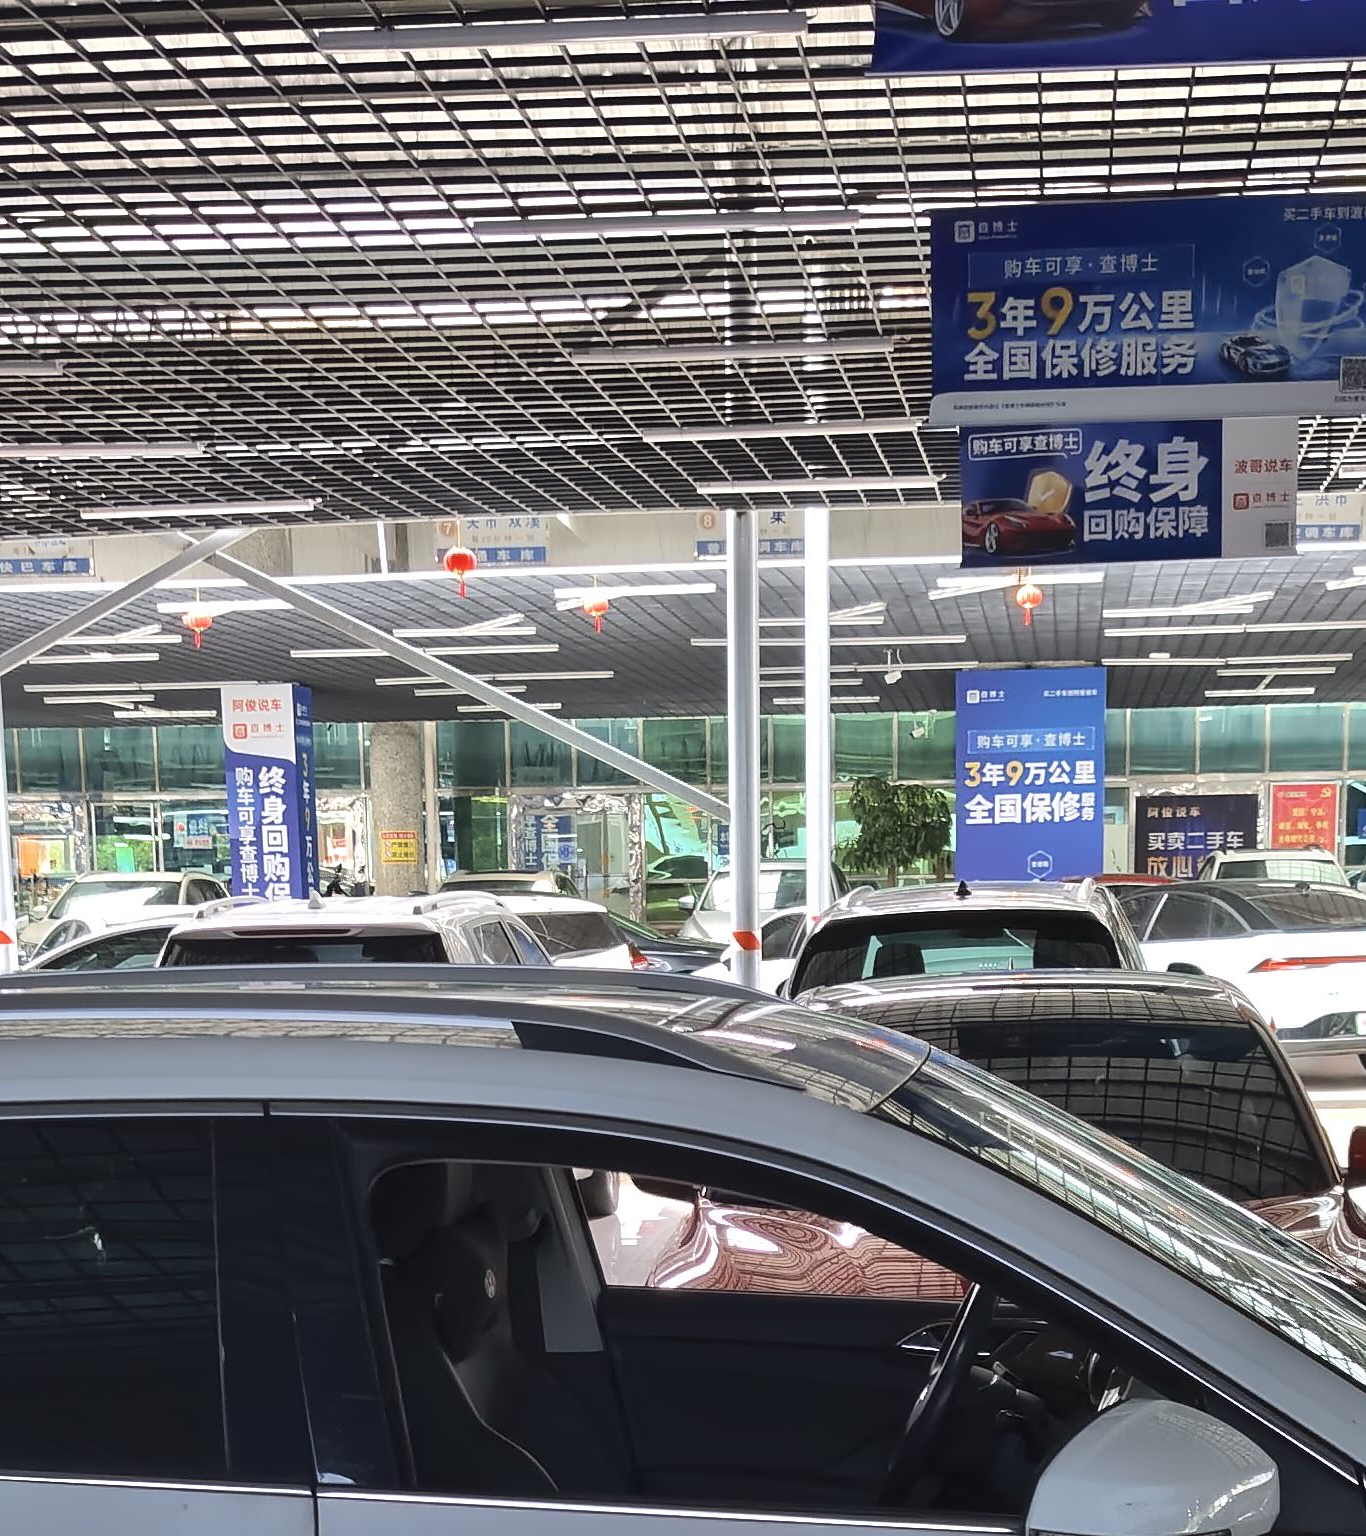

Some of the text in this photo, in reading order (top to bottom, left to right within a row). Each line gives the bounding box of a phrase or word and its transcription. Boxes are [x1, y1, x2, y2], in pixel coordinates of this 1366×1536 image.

[1004, 253, 1159, 279] 购车可享·查博士
[967, 287, 1195, 340] 3年9万公里
[964, 337, 1196, 381] 全国保修服务
[972, 432, 1079, 456] 购车可享查博士
[1084, 436, 1209, 503] 终身
[1235, 458, 1292, 475] 波哥说车
[443, 522, 452, 536] 7
[703, 513, 712, 528] 8
[1083, 505, 1209, 542] 回购保障
[232, 699, 282, 712] 阿俊说车
[977, 732, 1085, 749] 购车可享·查博士
[964, 760, 1096, 787] 3年9万公里
[1147, 806, 1201, 818] 阿俊说车
[235, 767, 260, 898] 购车可享查博士
[1147, 831, 1244, 850] 买卖二手车
[1146, 855, 1206, 878] 放心
